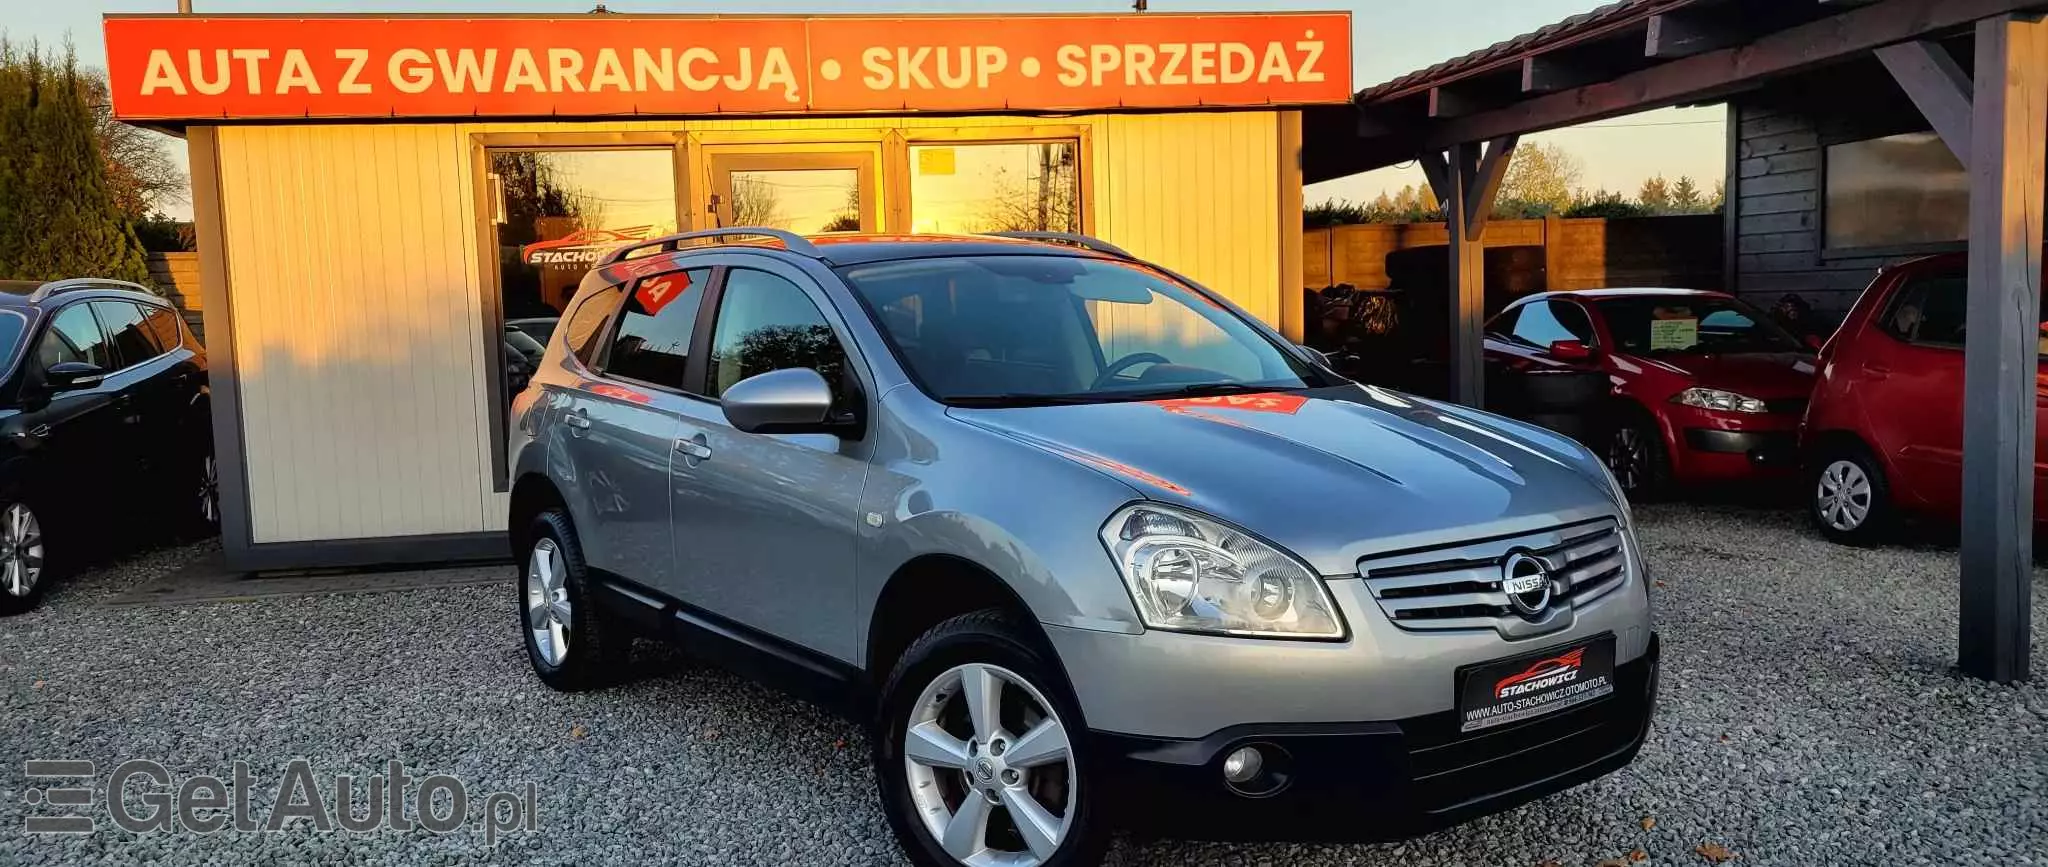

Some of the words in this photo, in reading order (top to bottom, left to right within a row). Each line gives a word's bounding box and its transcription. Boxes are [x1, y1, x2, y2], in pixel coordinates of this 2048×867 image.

[139, 48, 322, 96] AUTA
[334, 48, 373, 94] Z
[386, 47, 801, 103] GWARANCJĄ
[862, 45, 1009, 91] SKUP
[1056, 29, 1326, 88] SPRZEDAŻ
[529, 250, 605, 264] STACHO
[1466, 675, 1608, 721] WWW.AUTO-STACHOWICZ.OTOMOTO.PL
[1499, 669, 1580, 699] STACHOWICZ
